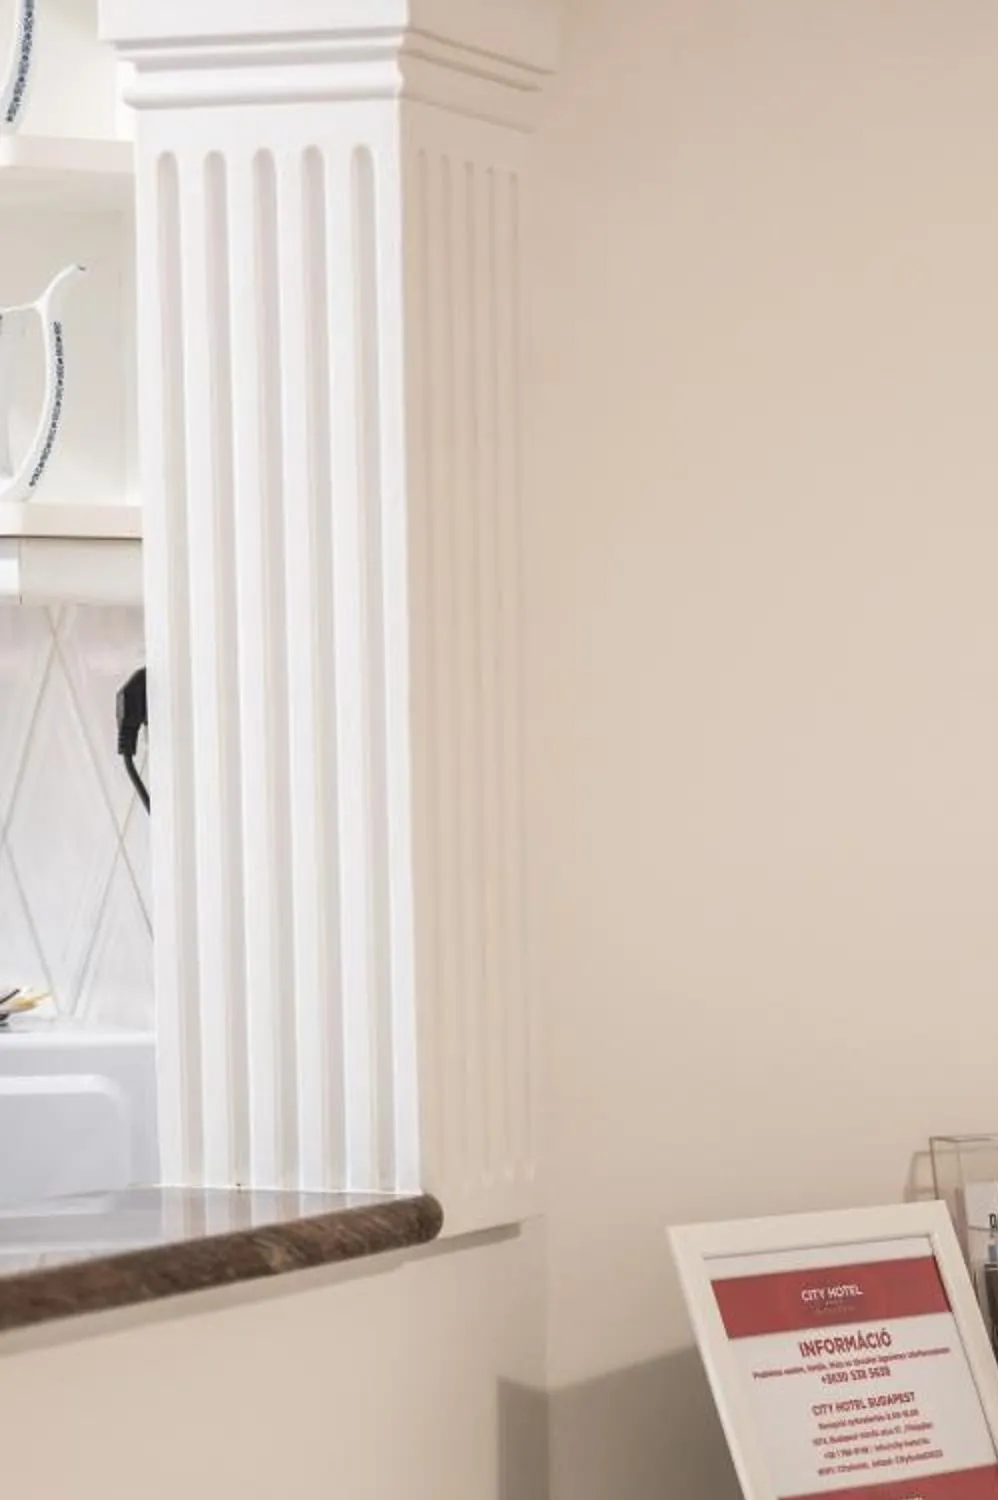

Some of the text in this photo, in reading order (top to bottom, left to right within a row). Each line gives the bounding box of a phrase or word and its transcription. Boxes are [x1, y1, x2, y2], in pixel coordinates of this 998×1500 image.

[802, 1284, 864, 1302] CITY HOTEL
[799, 1327, 892, 1358] INFORMÁCIÓ
[812, 1392, 915, 1416] CITY HOTEL BUDAPEST
